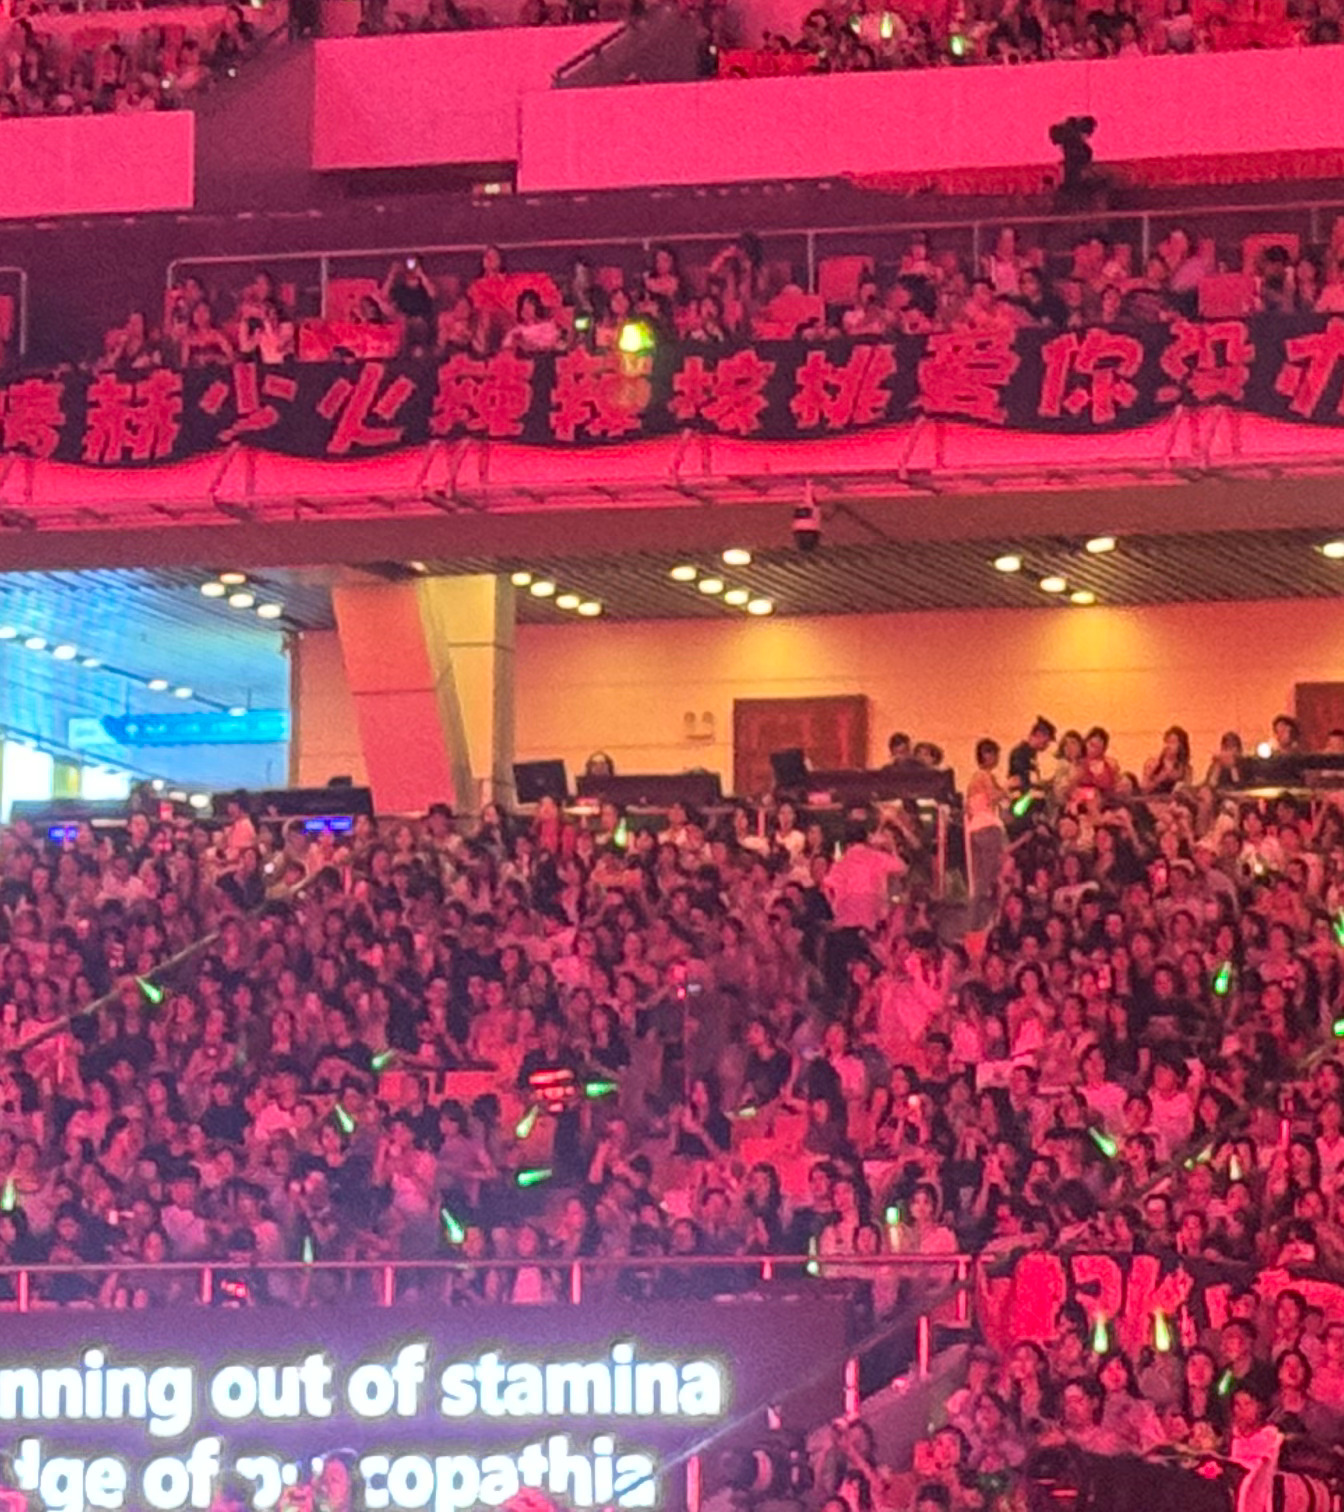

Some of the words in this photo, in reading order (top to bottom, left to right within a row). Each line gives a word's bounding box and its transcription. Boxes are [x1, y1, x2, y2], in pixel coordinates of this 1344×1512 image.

[210, 1352, 334, 1419] out
[346, 1342, 427, 1418] of
[440, 1342, 723, 1418] stamina
[142, 1437, 222, 1510] of
